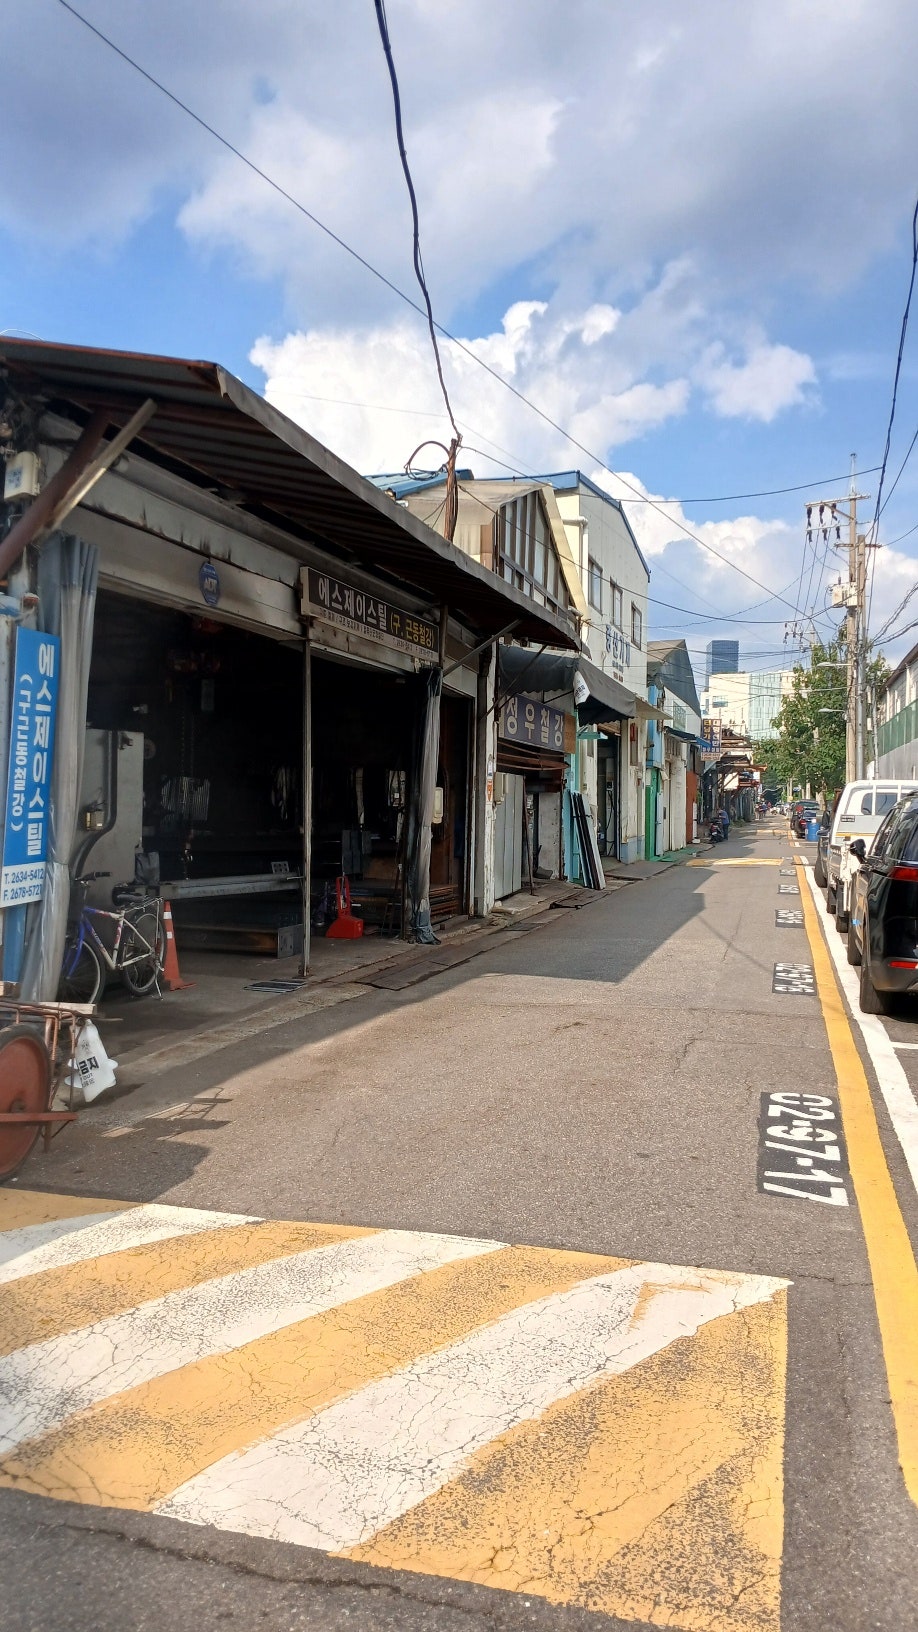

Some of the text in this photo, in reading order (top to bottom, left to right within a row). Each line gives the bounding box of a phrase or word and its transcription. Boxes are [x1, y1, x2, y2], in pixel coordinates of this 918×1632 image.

[318, 577, 387, 631] 에스제이스틸
[10, 673, 33, 832] (구근동철강)
[27, 643, 55, 856] 에스제이스틸
[763, 1092, 850, 1207] 02-97-17
